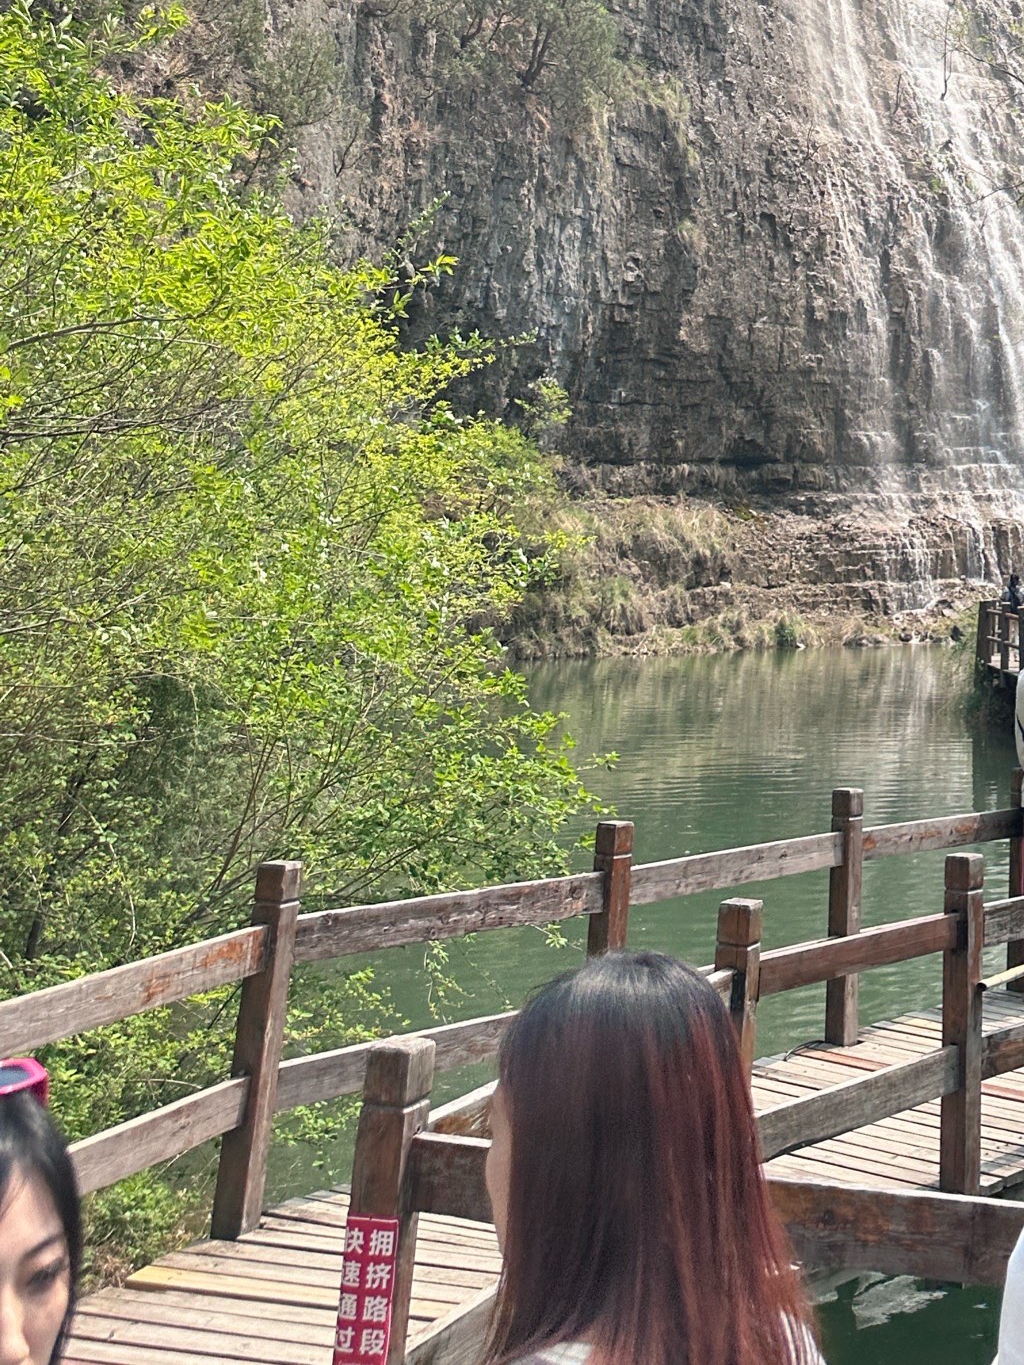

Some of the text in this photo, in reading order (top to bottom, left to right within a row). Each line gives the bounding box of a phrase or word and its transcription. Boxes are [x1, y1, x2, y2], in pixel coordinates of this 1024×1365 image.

[335, 1227, 365, 1353] 快速通过
[359, 1229, 395, 1355] 拥挤路段
